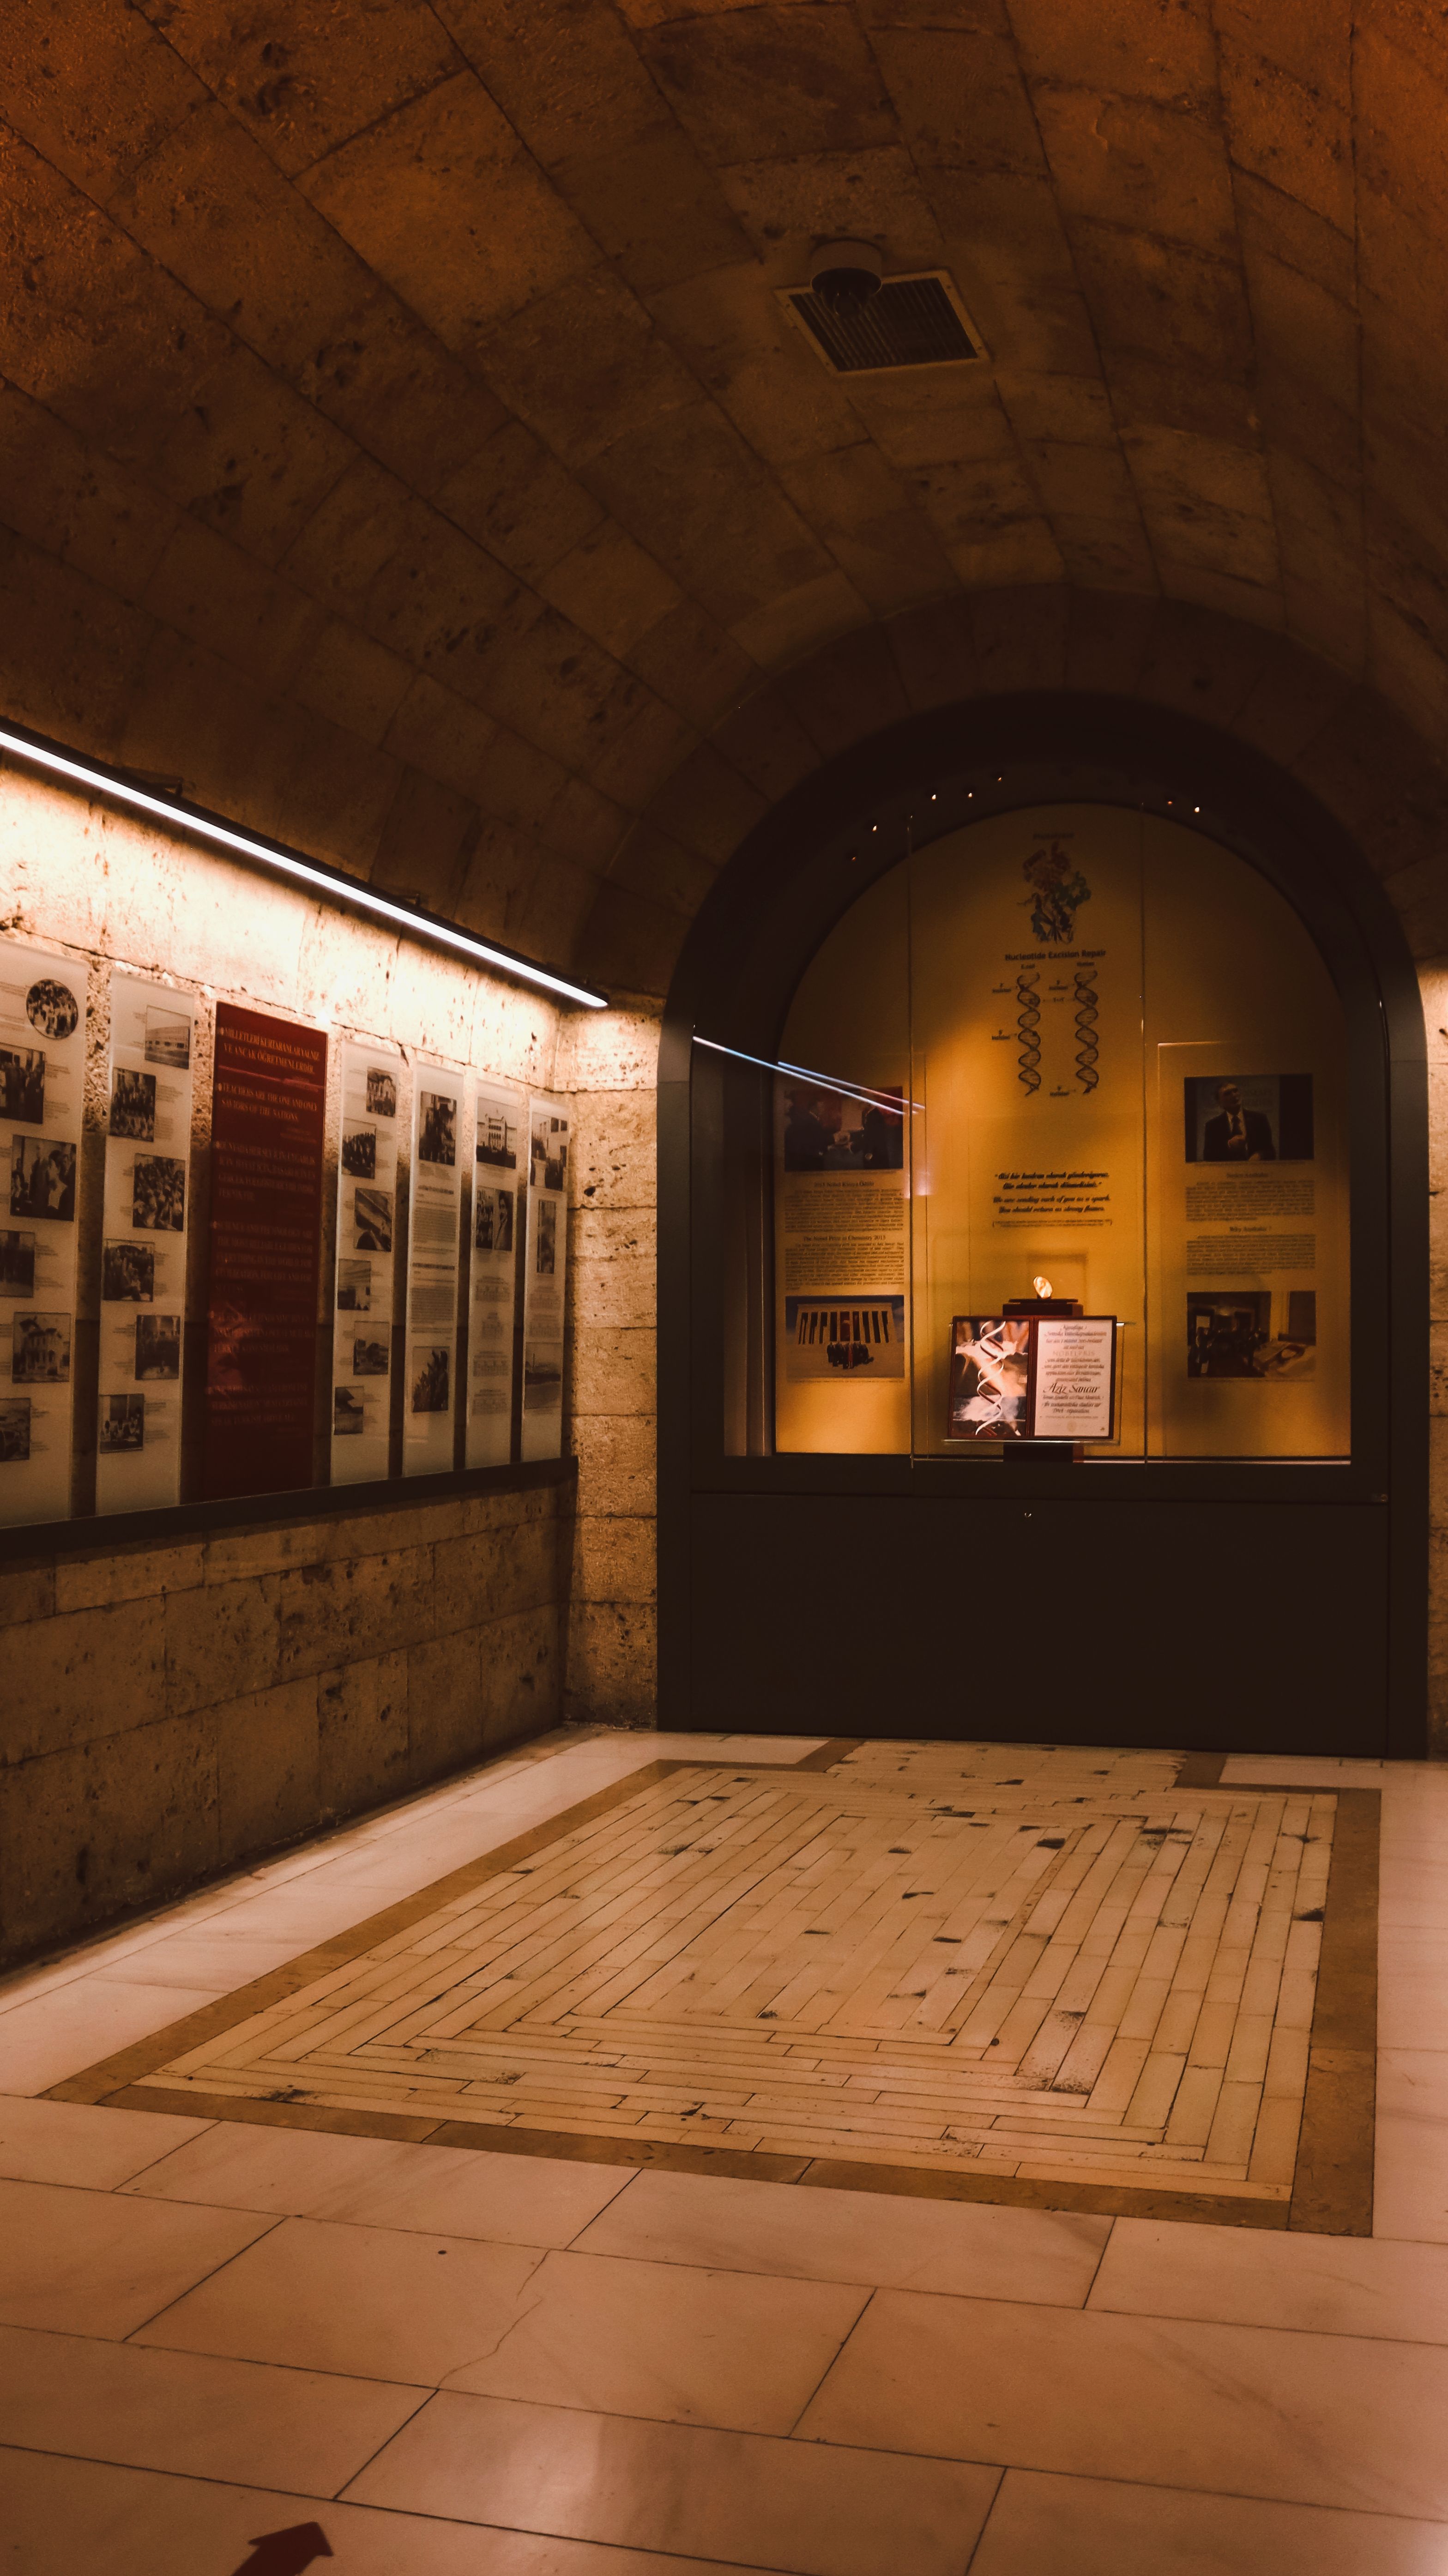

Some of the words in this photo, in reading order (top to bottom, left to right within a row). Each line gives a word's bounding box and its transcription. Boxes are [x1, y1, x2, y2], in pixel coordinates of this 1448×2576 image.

[1005, 952, 1046, 961] Nucleotide
[1048, 950, 1080, 959] Excision
[1081, 949, 1106, 958] Repair
[1043, 1382, 1068, 1394] Aziz
[1069, 1385, 1100, 1393] Sancar
